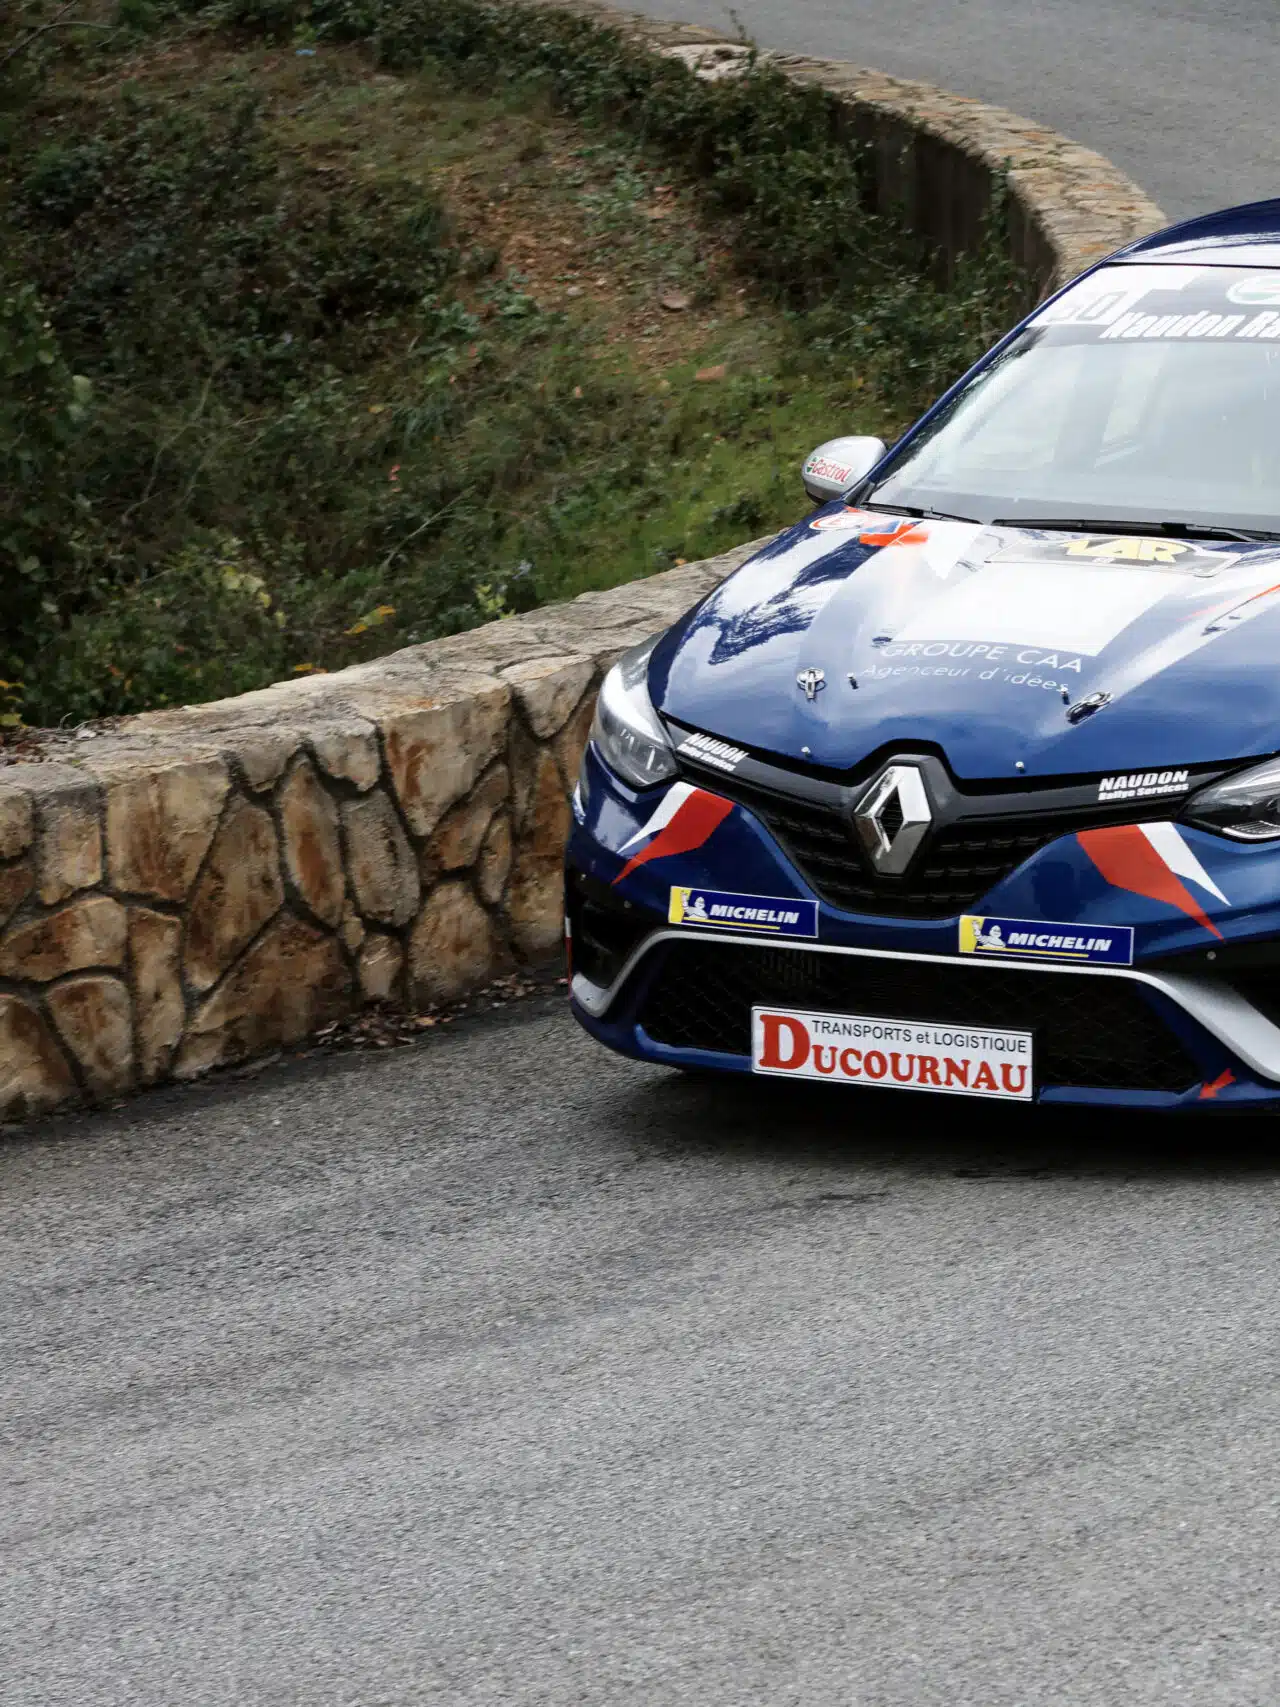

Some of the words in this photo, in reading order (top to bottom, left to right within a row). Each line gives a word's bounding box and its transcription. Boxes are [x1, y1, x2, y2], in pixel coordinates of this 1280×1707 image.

[1099, 310, 1246, 338] Naudon
[812, 458, 852, 482] Castrol
[880, 643, 1008, 660] GROUPE
[1016, 650, 1082, 674] CAA
[862, 664, 969, 678] Agenceur
[684, 732, 750, 763] NAUDON
[1098, 770, 1188, 792] NAUDON
[1098, 790, 1135, 800] Rallye
[1137, 784, 1190, 796] Services
[710, 904, 799, 924] MICHELIN
[1008, 932, 1112, 952] MICHELIN
[812, 1020, 912, 1042] TRANSPORTS
[916, 1032, 930, 1044] et
[934, 1032, 1027, 1053] LOGISTIQUE
[759, 1014, 1027, 1093] DUCOURNAU
